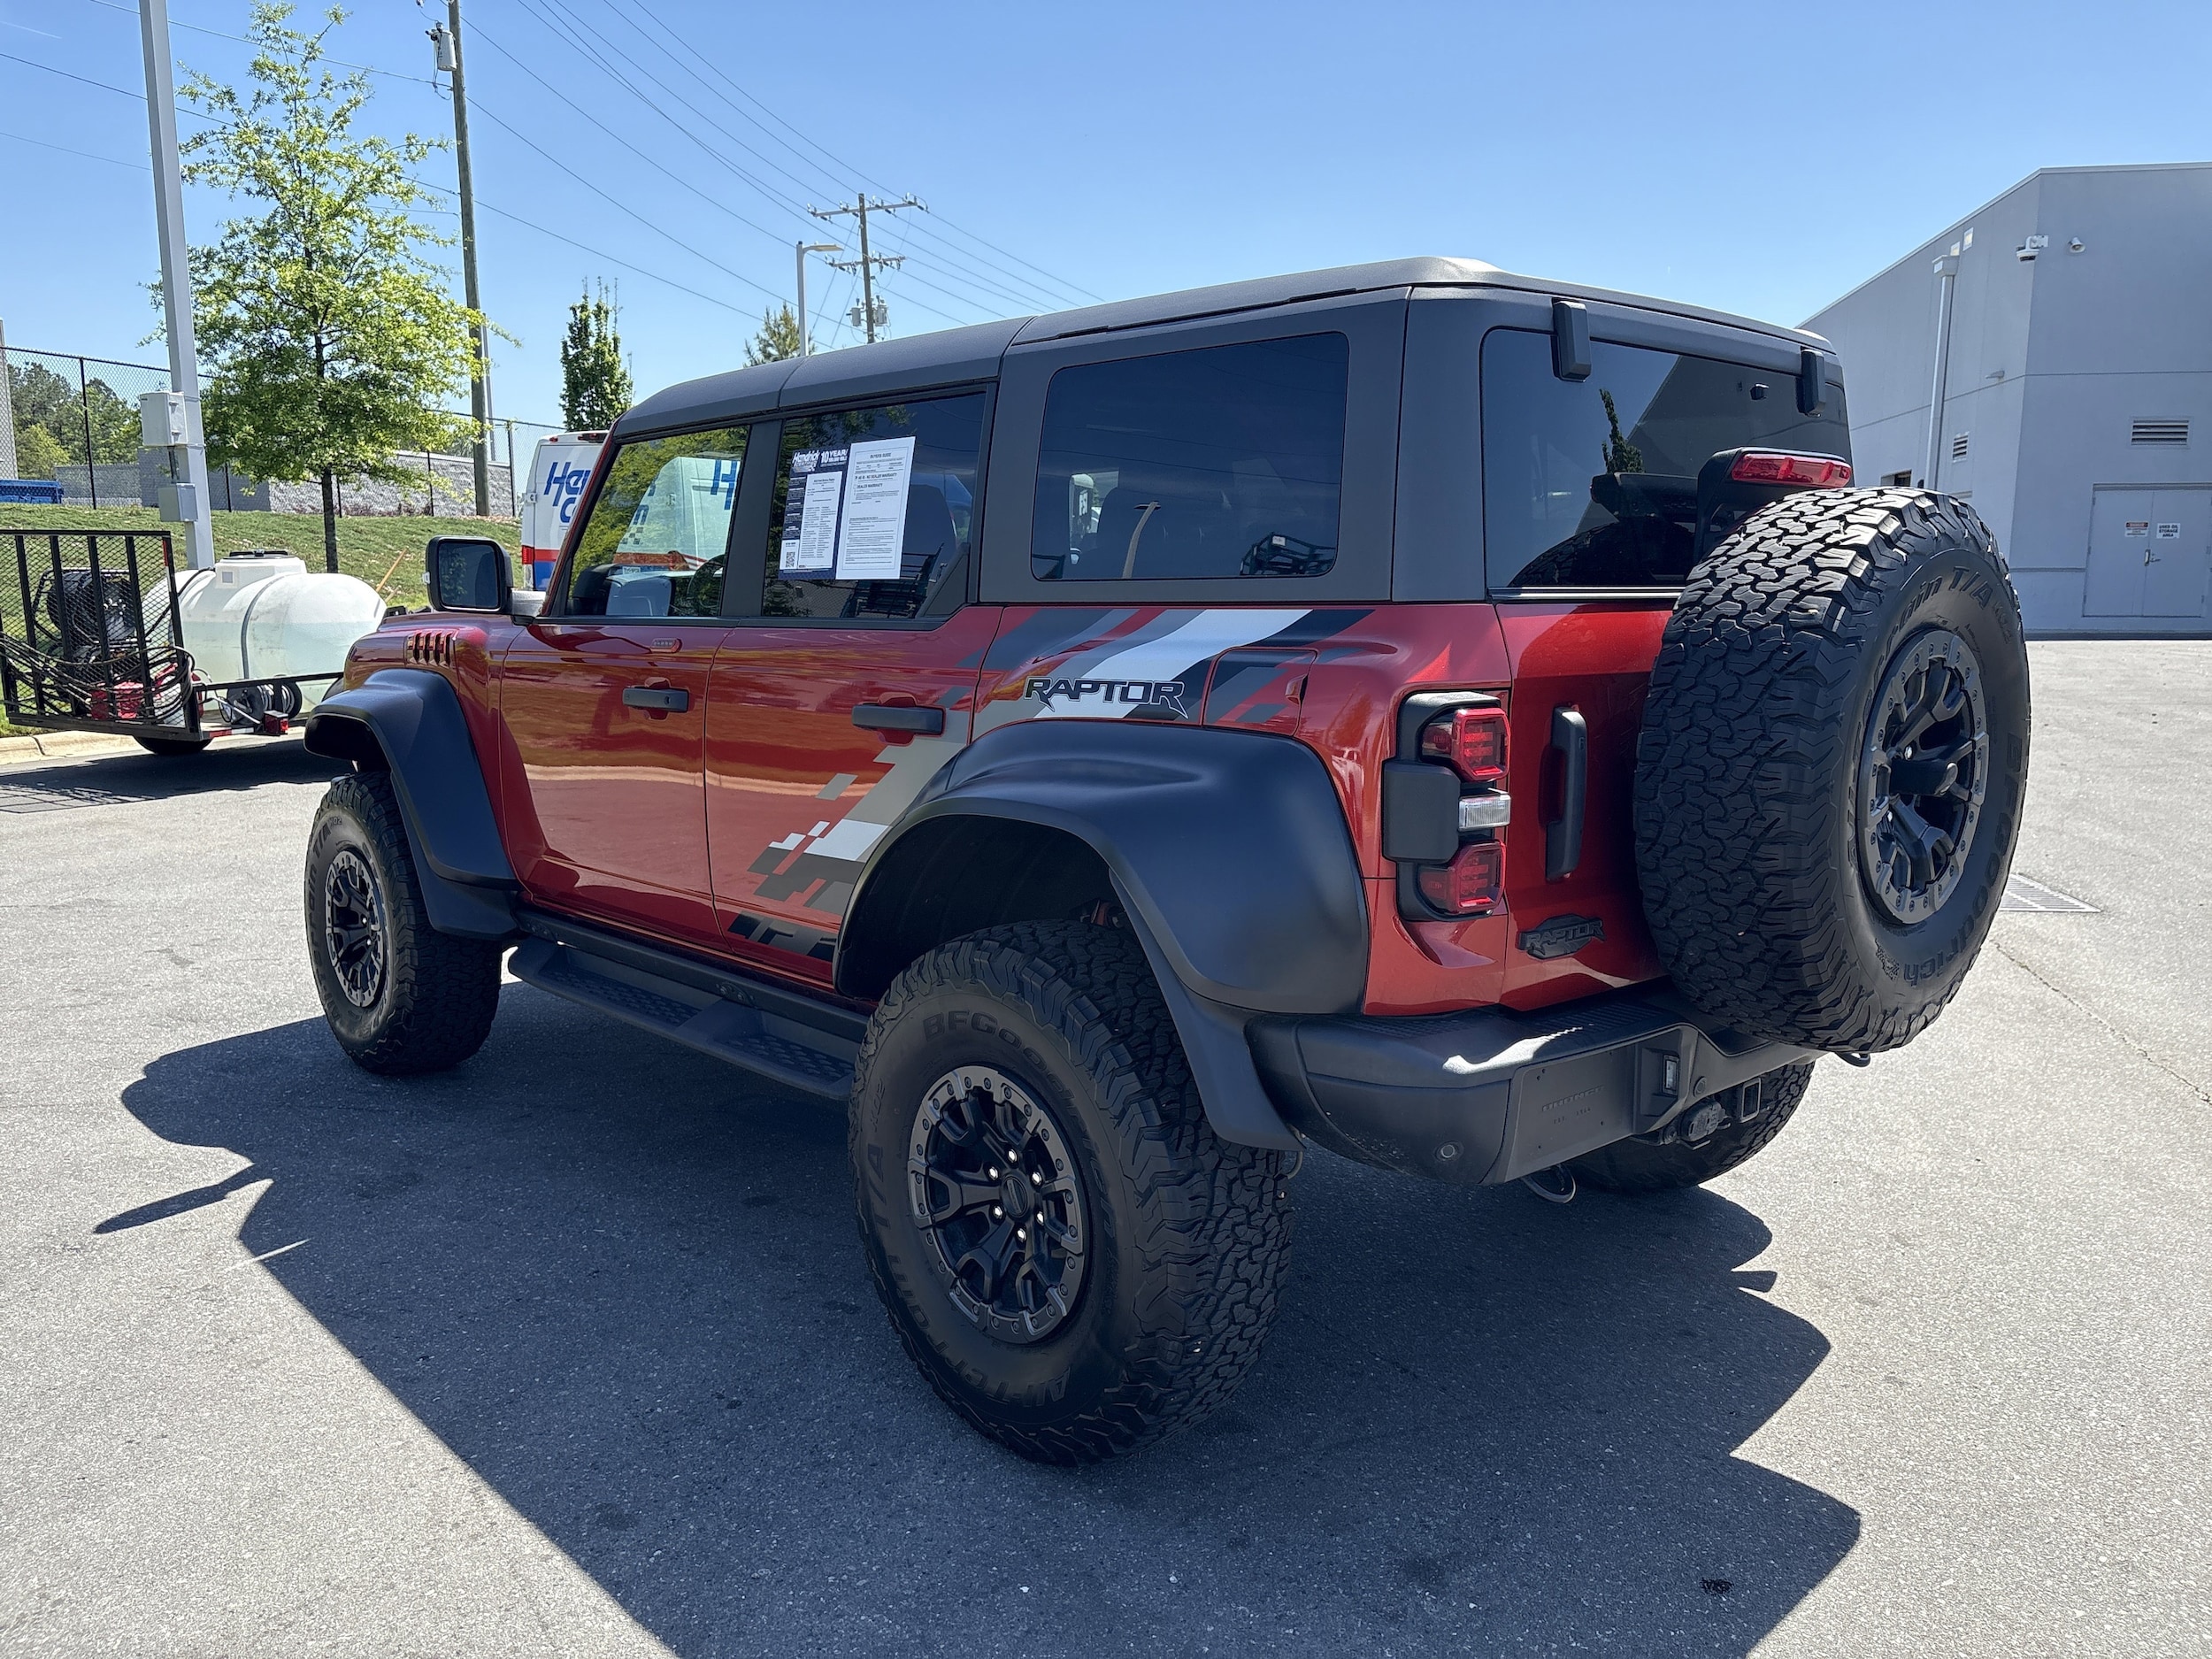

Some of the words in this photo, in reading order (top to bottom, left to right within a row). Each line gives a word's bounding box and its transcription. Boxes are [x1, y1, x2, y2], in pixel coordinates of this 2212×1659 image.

[821, 451, 829, 463] 10
[1947, 566, 1993, 611] T/A
[1024, 676, 1189, 719] RAPTOR
[313, 823, 331, 857] T/A
[1525, 919, 1606, 956] RAPTOR
[866, 1143, 892, 1230] T/A
